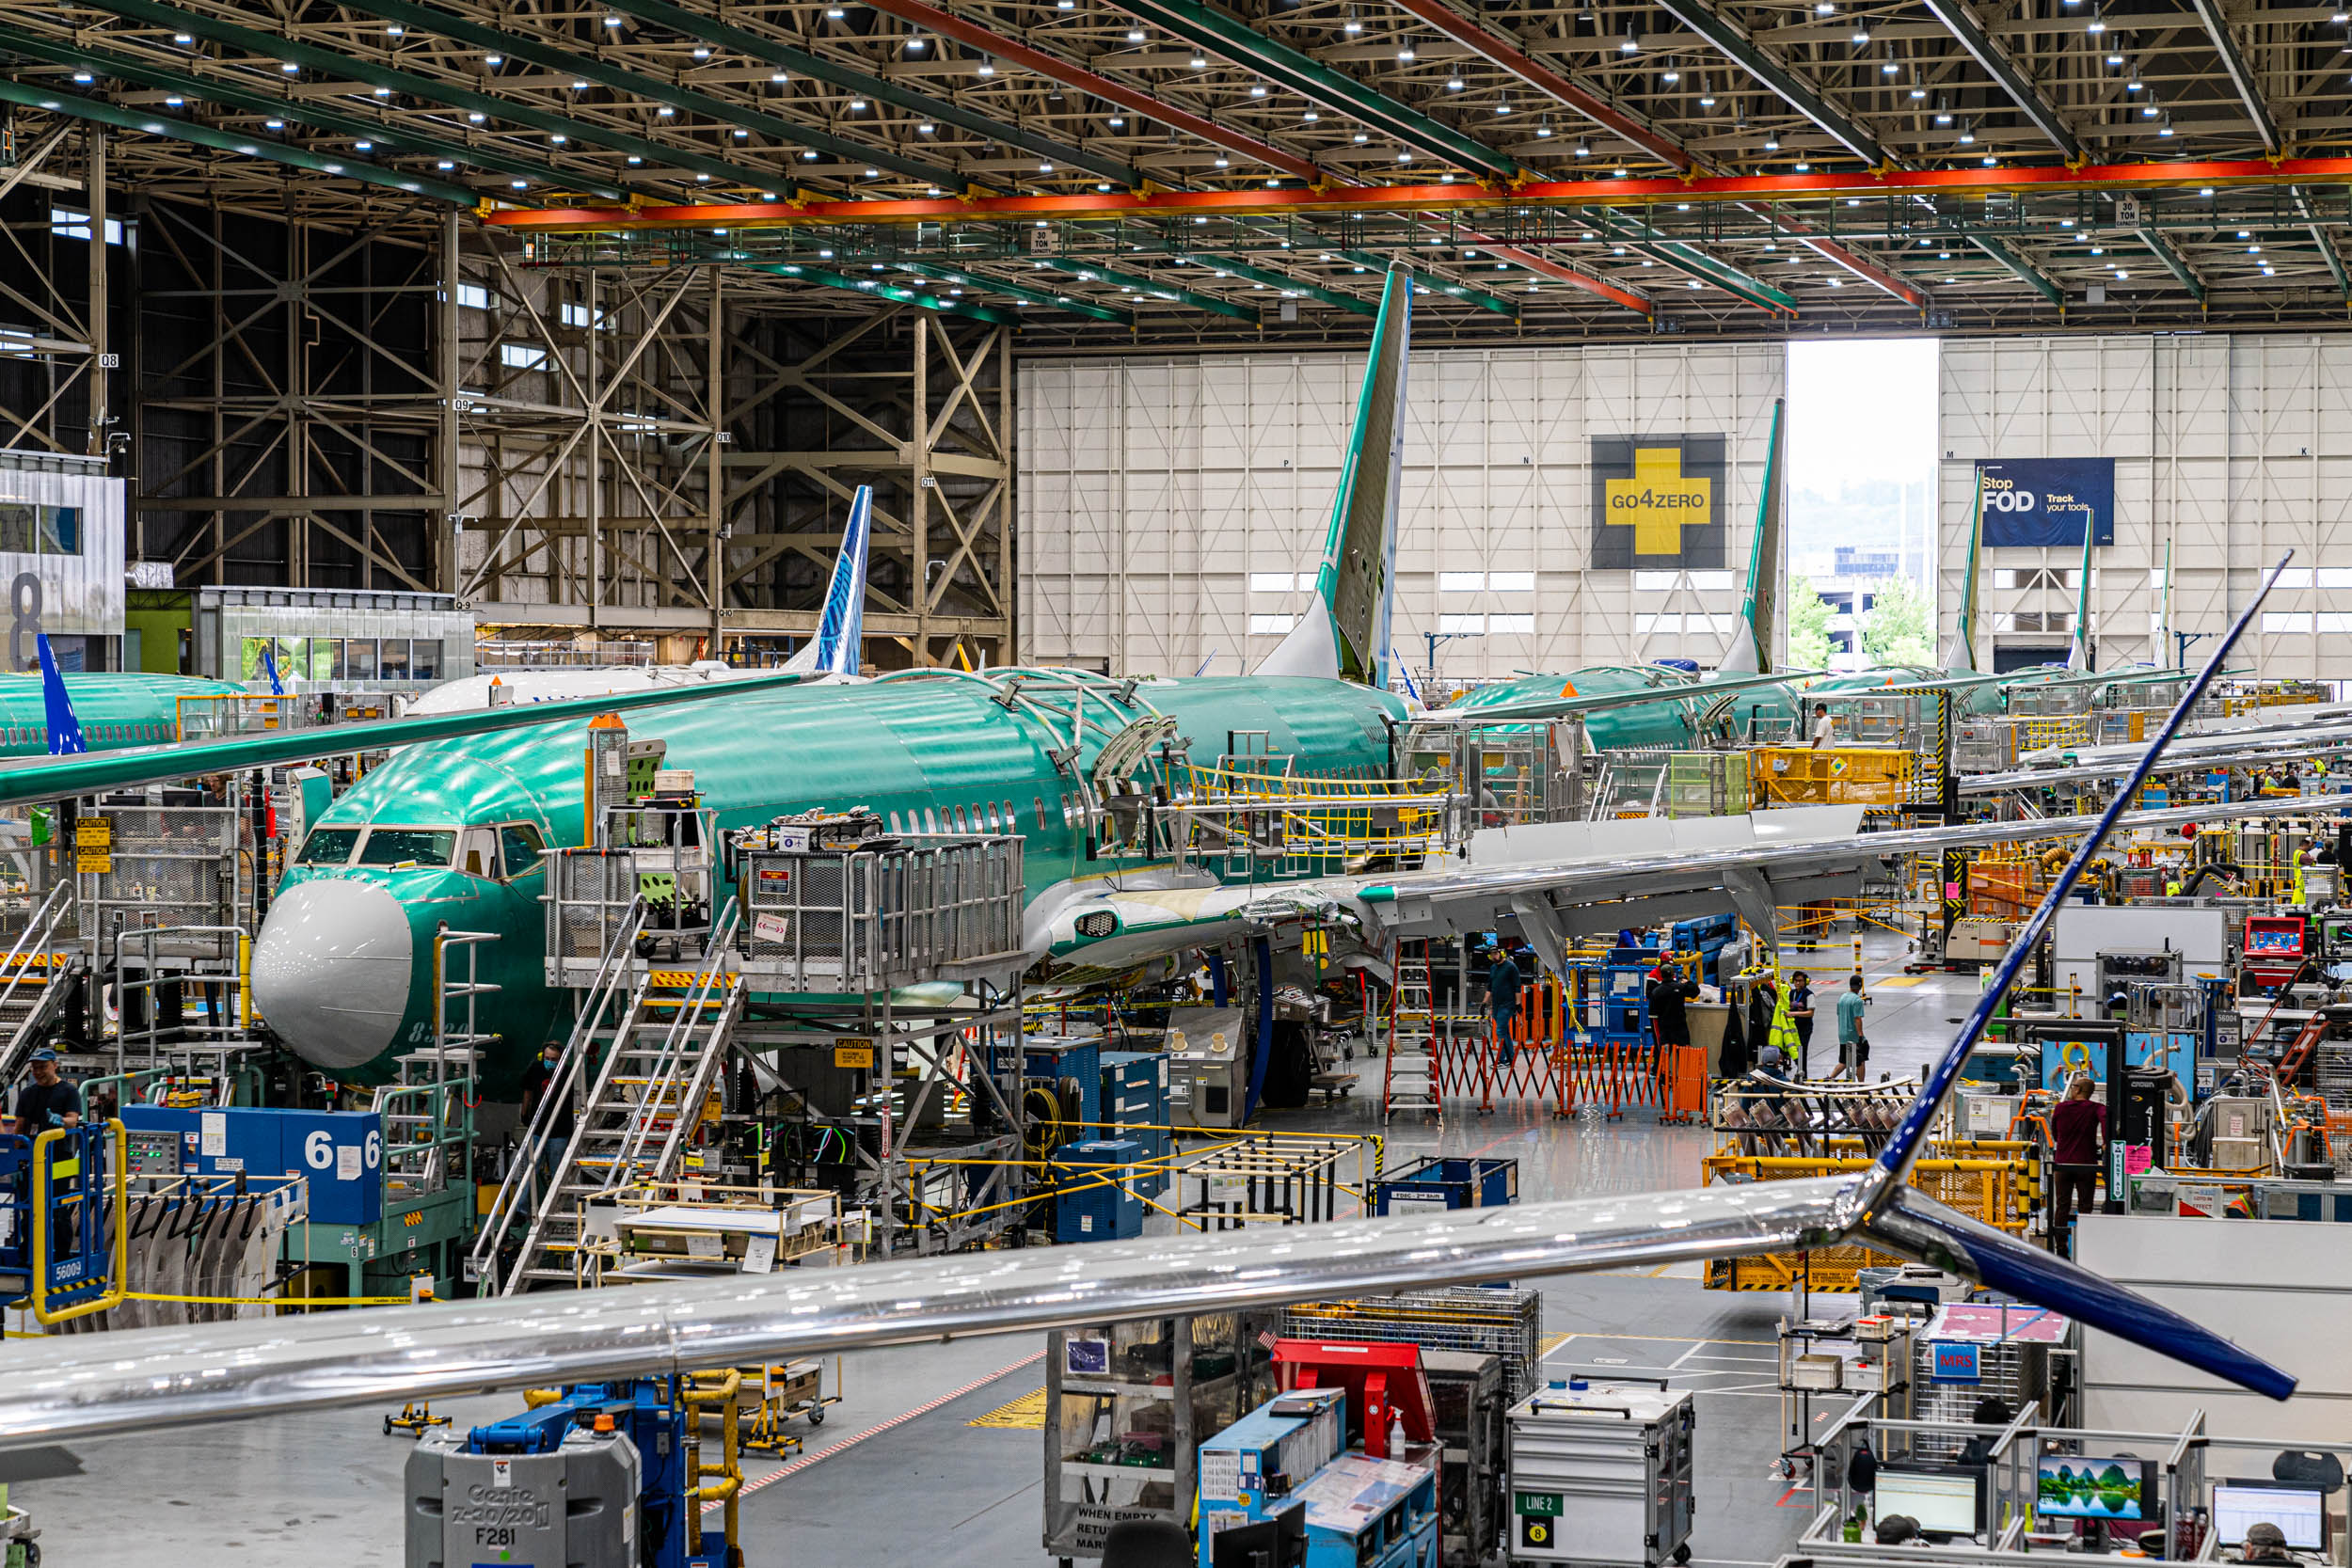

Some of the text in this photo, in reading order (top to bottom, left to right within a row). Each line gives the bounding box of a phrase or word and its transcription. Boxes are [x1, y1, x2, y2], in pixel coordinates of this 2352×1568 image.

[2122, 202, 2133, 211] 30
[102, 355, 118, 367] Q8
[455, 400, 469, 410] Q9
[717, 433, 730, 442] Q10
[1947, 451, 1954, 459] M
[2301, 447, 2307, 455] K
[922, 478, 935, 486] Q11
[1983, 477, 2013, 491] Stop
[1612, 489, 1705, 509] GO4ZERO
[1982, 491, 2035, 513] FOD
[2046, 494, 2074, 503] Track
[2046, 502, 2090, 514] your tools
[456, 601, 470, 610] Q-9
[9, 572, 43, 673] 8
[79, 819, 107, 828] CAUTION
[79, 847, 108, 855] CAUTION
[837, 1039, 871, 1048] CAUTION
[305, 1131, 333, 1169] 6
[365, 1130, 380, 1169] 6
[352, 1248, 358, 1257] 6
[56, 1261, 82, 1280] 56009
[1940, 1354, 1973, 1368] MRS
[468, 1484, 534, 1505] Genie
[1526, 1496, 1552, 1511] LINE 2
[1078, 1507, 1110, 1521] WHEN
[1076, 1523, 1110, 1535] RETU
[1534, 1528, 1542, 1540] 8
[476, 1528, 516, 1545] F281
[1076, 1538, 1106, 1549] MAR
